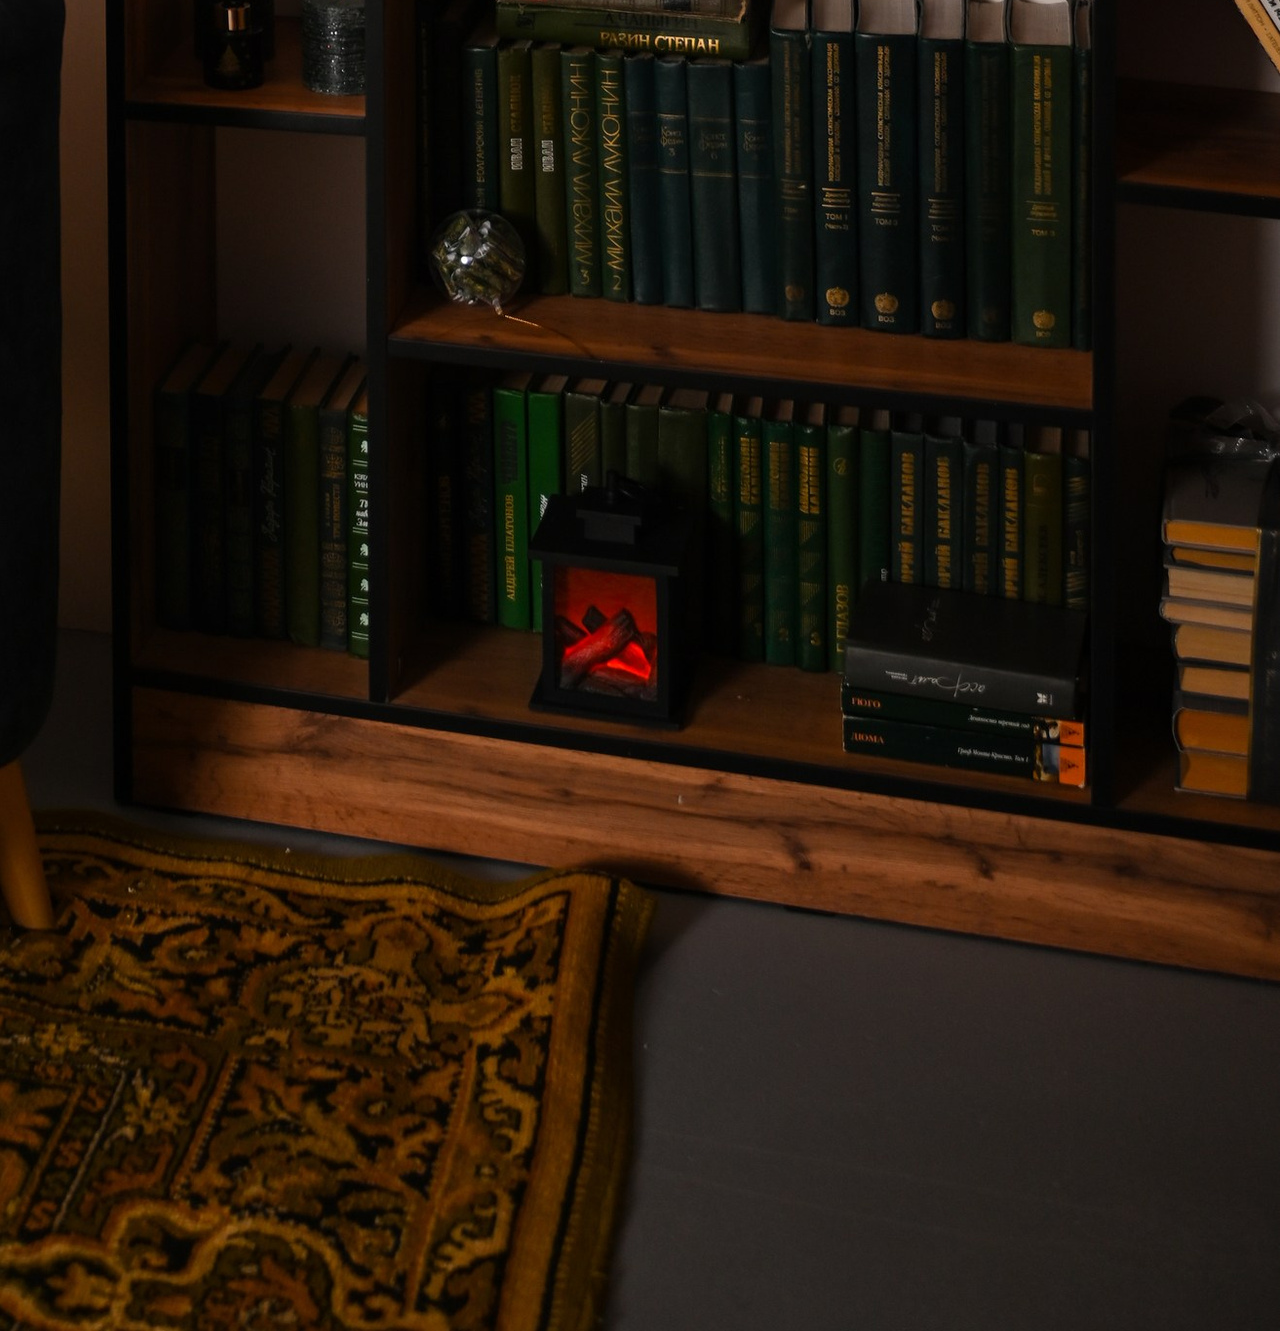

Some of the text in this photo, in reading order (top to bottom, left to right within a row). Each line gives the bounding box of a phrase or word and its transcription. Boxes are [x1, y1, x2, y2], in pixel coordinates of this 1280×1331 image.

[599, 30, 720, 55] РАЗИН СТЕПАН
[475, 68, 484, 116] ДЕТЕКТИВ
[570, 63, 592, 167] ЛУКОНИН
[601, 69, 623, 174] ЛУКОНИН
[476, 121, 485, 183] БОЛГАРСКИЙ
[511, 138, 523, 170] ИВАН
[541, 139, 555, 172] ИВАН
[580, 270, 590, 284] 3
[612, 275, 622, 290] 2
[901, 452, 915, 535] БАКЛАНОВ
[937, 456, 950, 538] БАКЛАНОВ
[1005, 468, 1018, 553] БАКЛАНОВ
[505, 495, 516, 552] ПЛАТОНОВ
[504, 556, 517, 600] АНДРЕЙ
[851, 695, 882, 709] ГЮГО
[851, 731, 886, 746] ДЮМА
